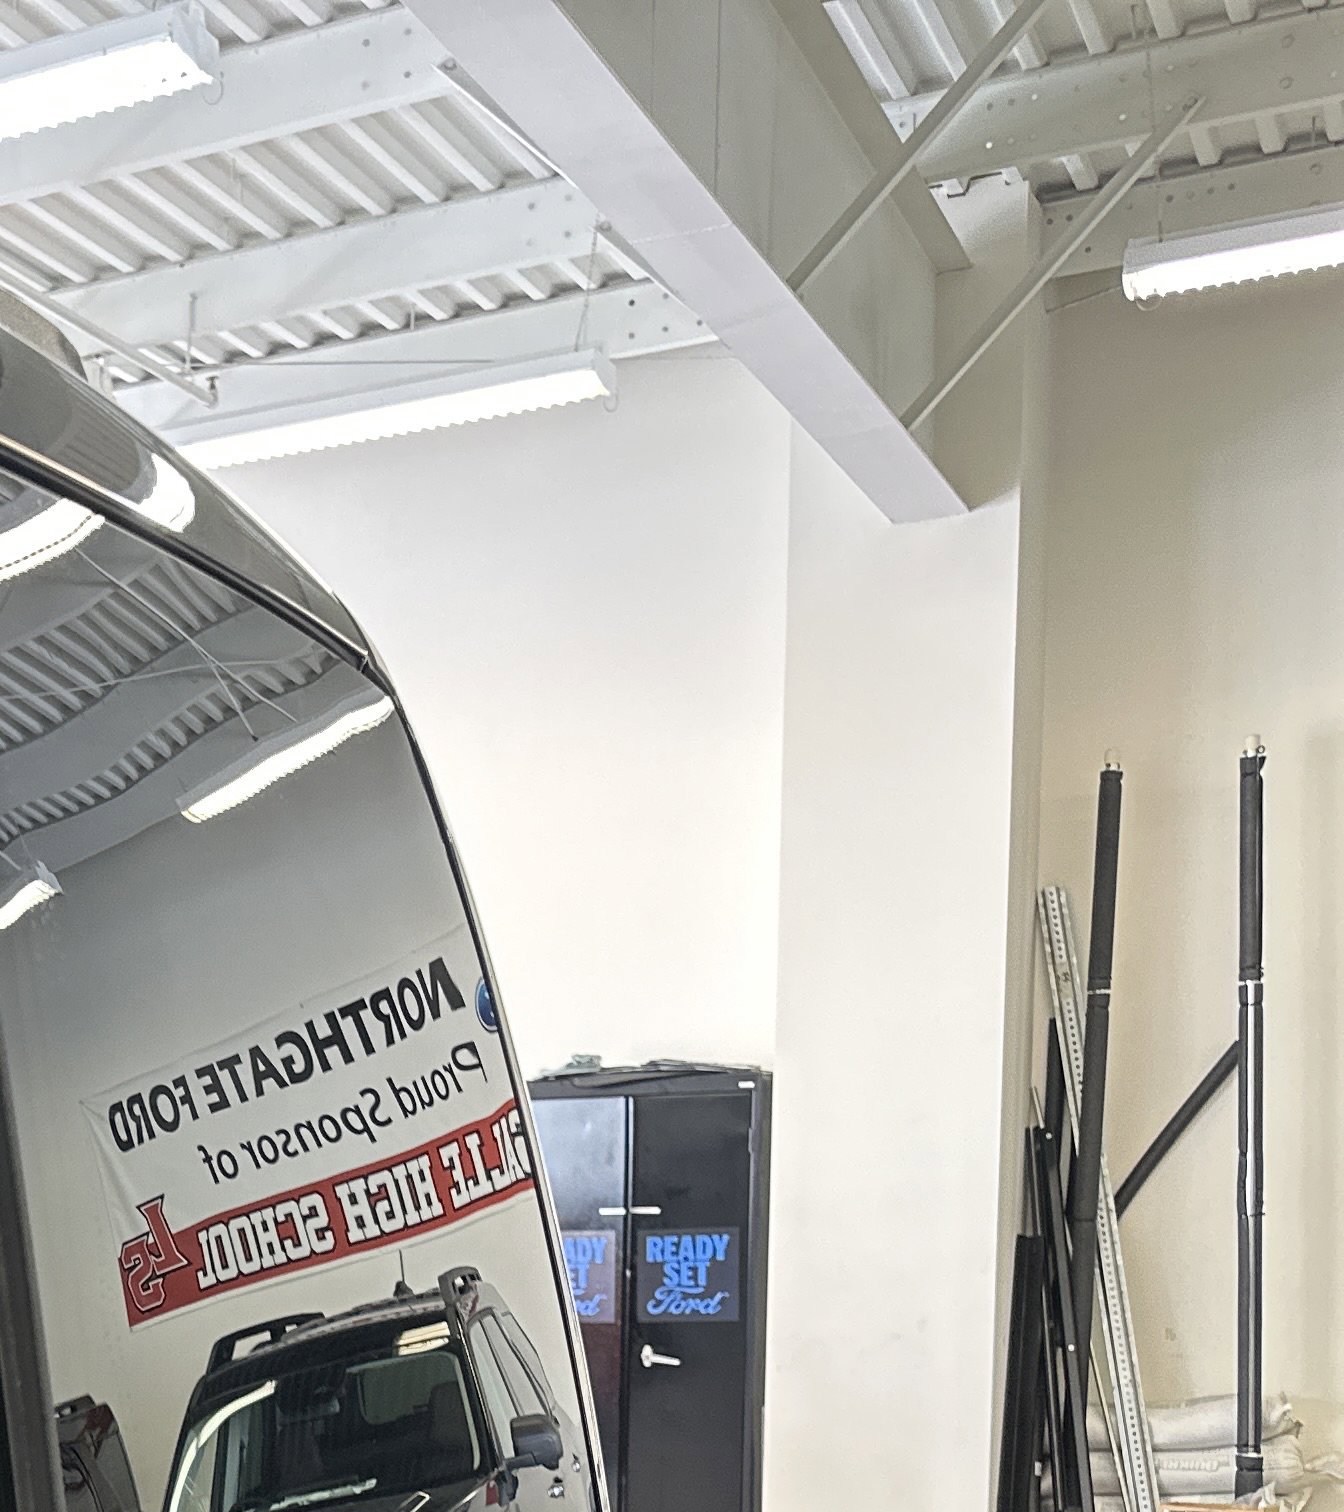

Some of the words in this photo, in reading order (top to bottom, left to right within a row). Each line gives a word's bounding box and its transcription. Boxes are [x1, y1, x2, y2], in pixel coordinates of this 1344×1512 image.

[646, 1234, 730, 1263] READY
[663, 1261, 712, 1287] SET
[646, 1286, 729, 1315] Ford
